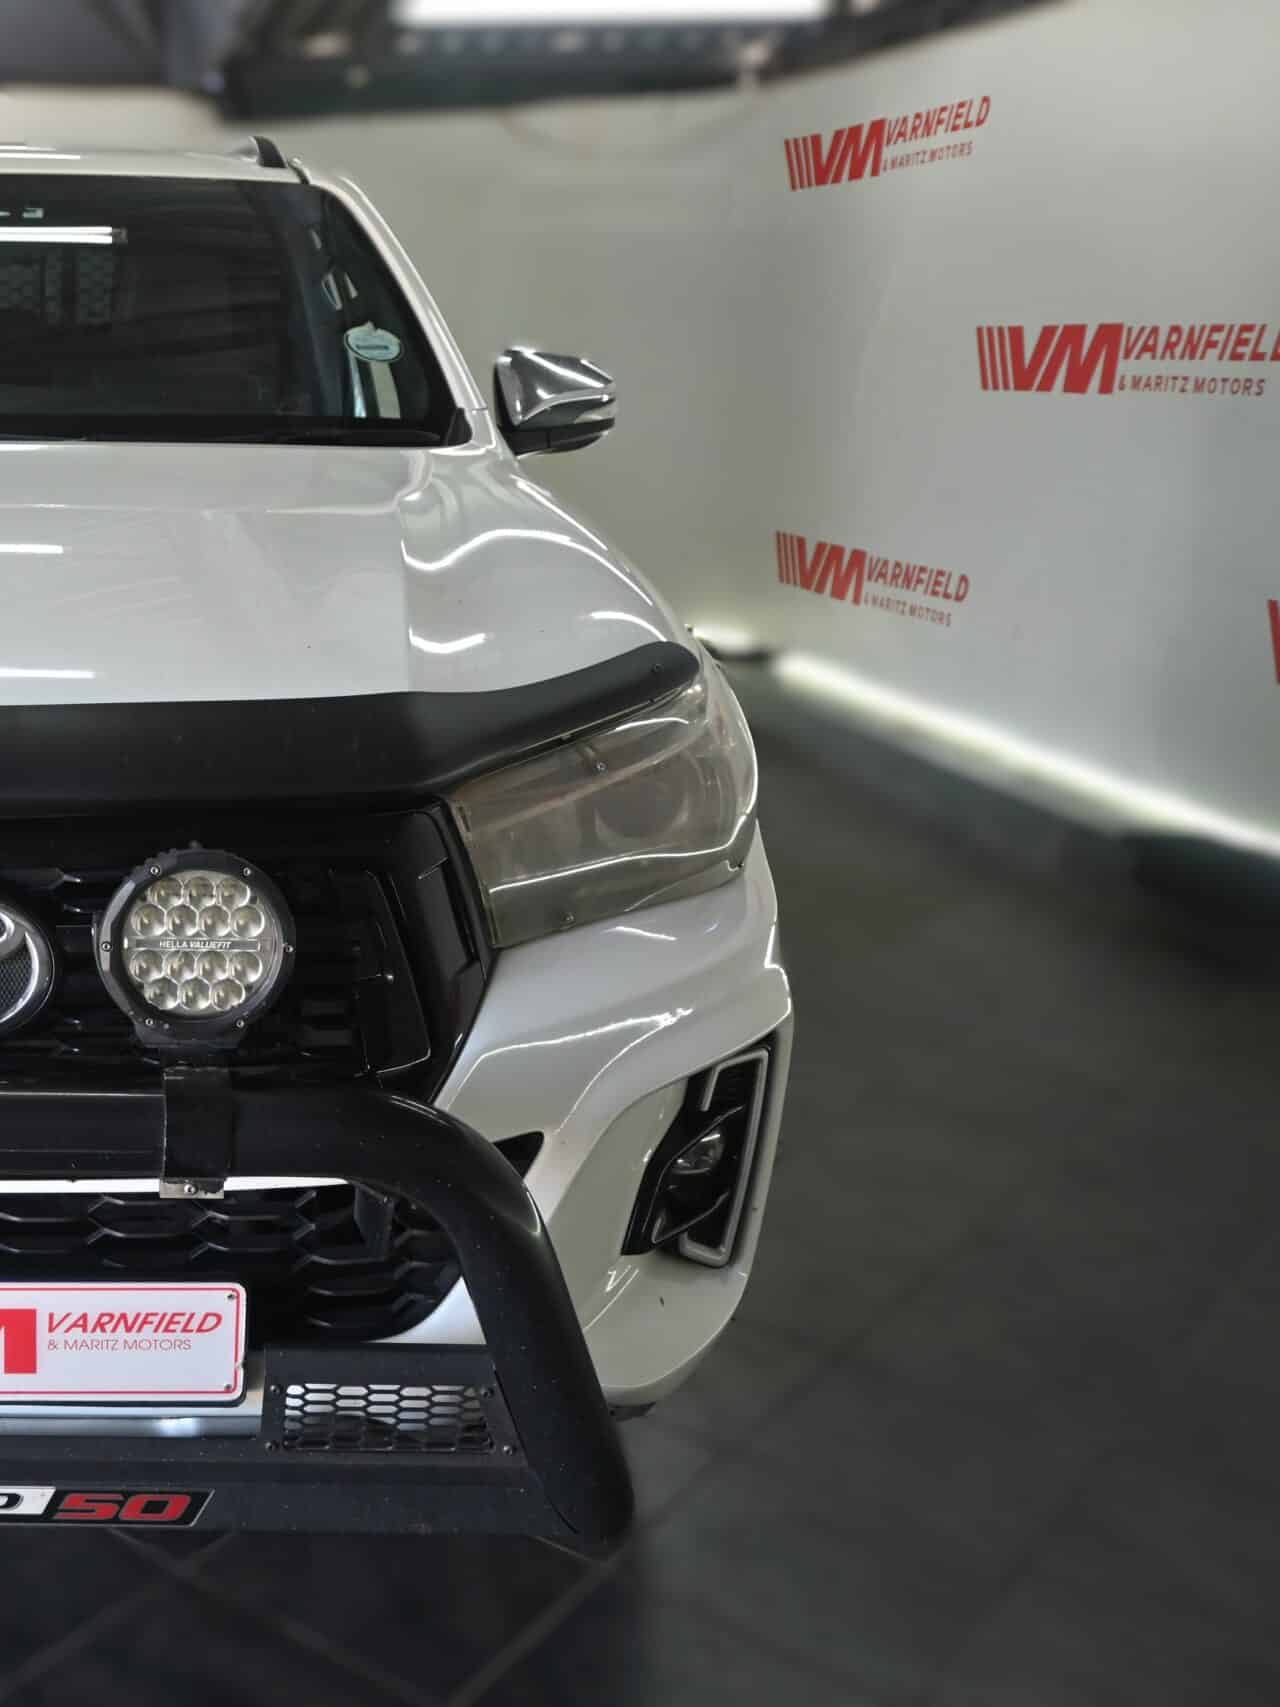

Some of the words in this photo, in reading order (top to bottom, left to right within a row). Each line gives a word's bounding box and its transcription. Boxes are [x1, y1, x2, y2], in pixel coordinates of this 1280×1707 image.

[885, 95, 991, 148] VARNFIELD
[811, 118, 887, 187] VM
[889, 150, 927, 171] MARITZ
[927, 141, 974, 163] MOTORS
[1008, 322, 1124, 394] VM
[1131, 375, 1190, 393] MARITZ
[1192, 376, 1266, 396] MOTORS
[797, 535, 868, 606] VM
[867, 556, 970, 603] VARNFIELD
[160, 940, 188, 949] HELLA
[47, 1312, 222, 1334] VARNFIELD
[47, 1338, 57, 1350] &
[63, 1338, 119, 1350] MARITZ
[123, 1338, 192, 1350] MOTORS
[51, 1493, 192, 1521] 50
